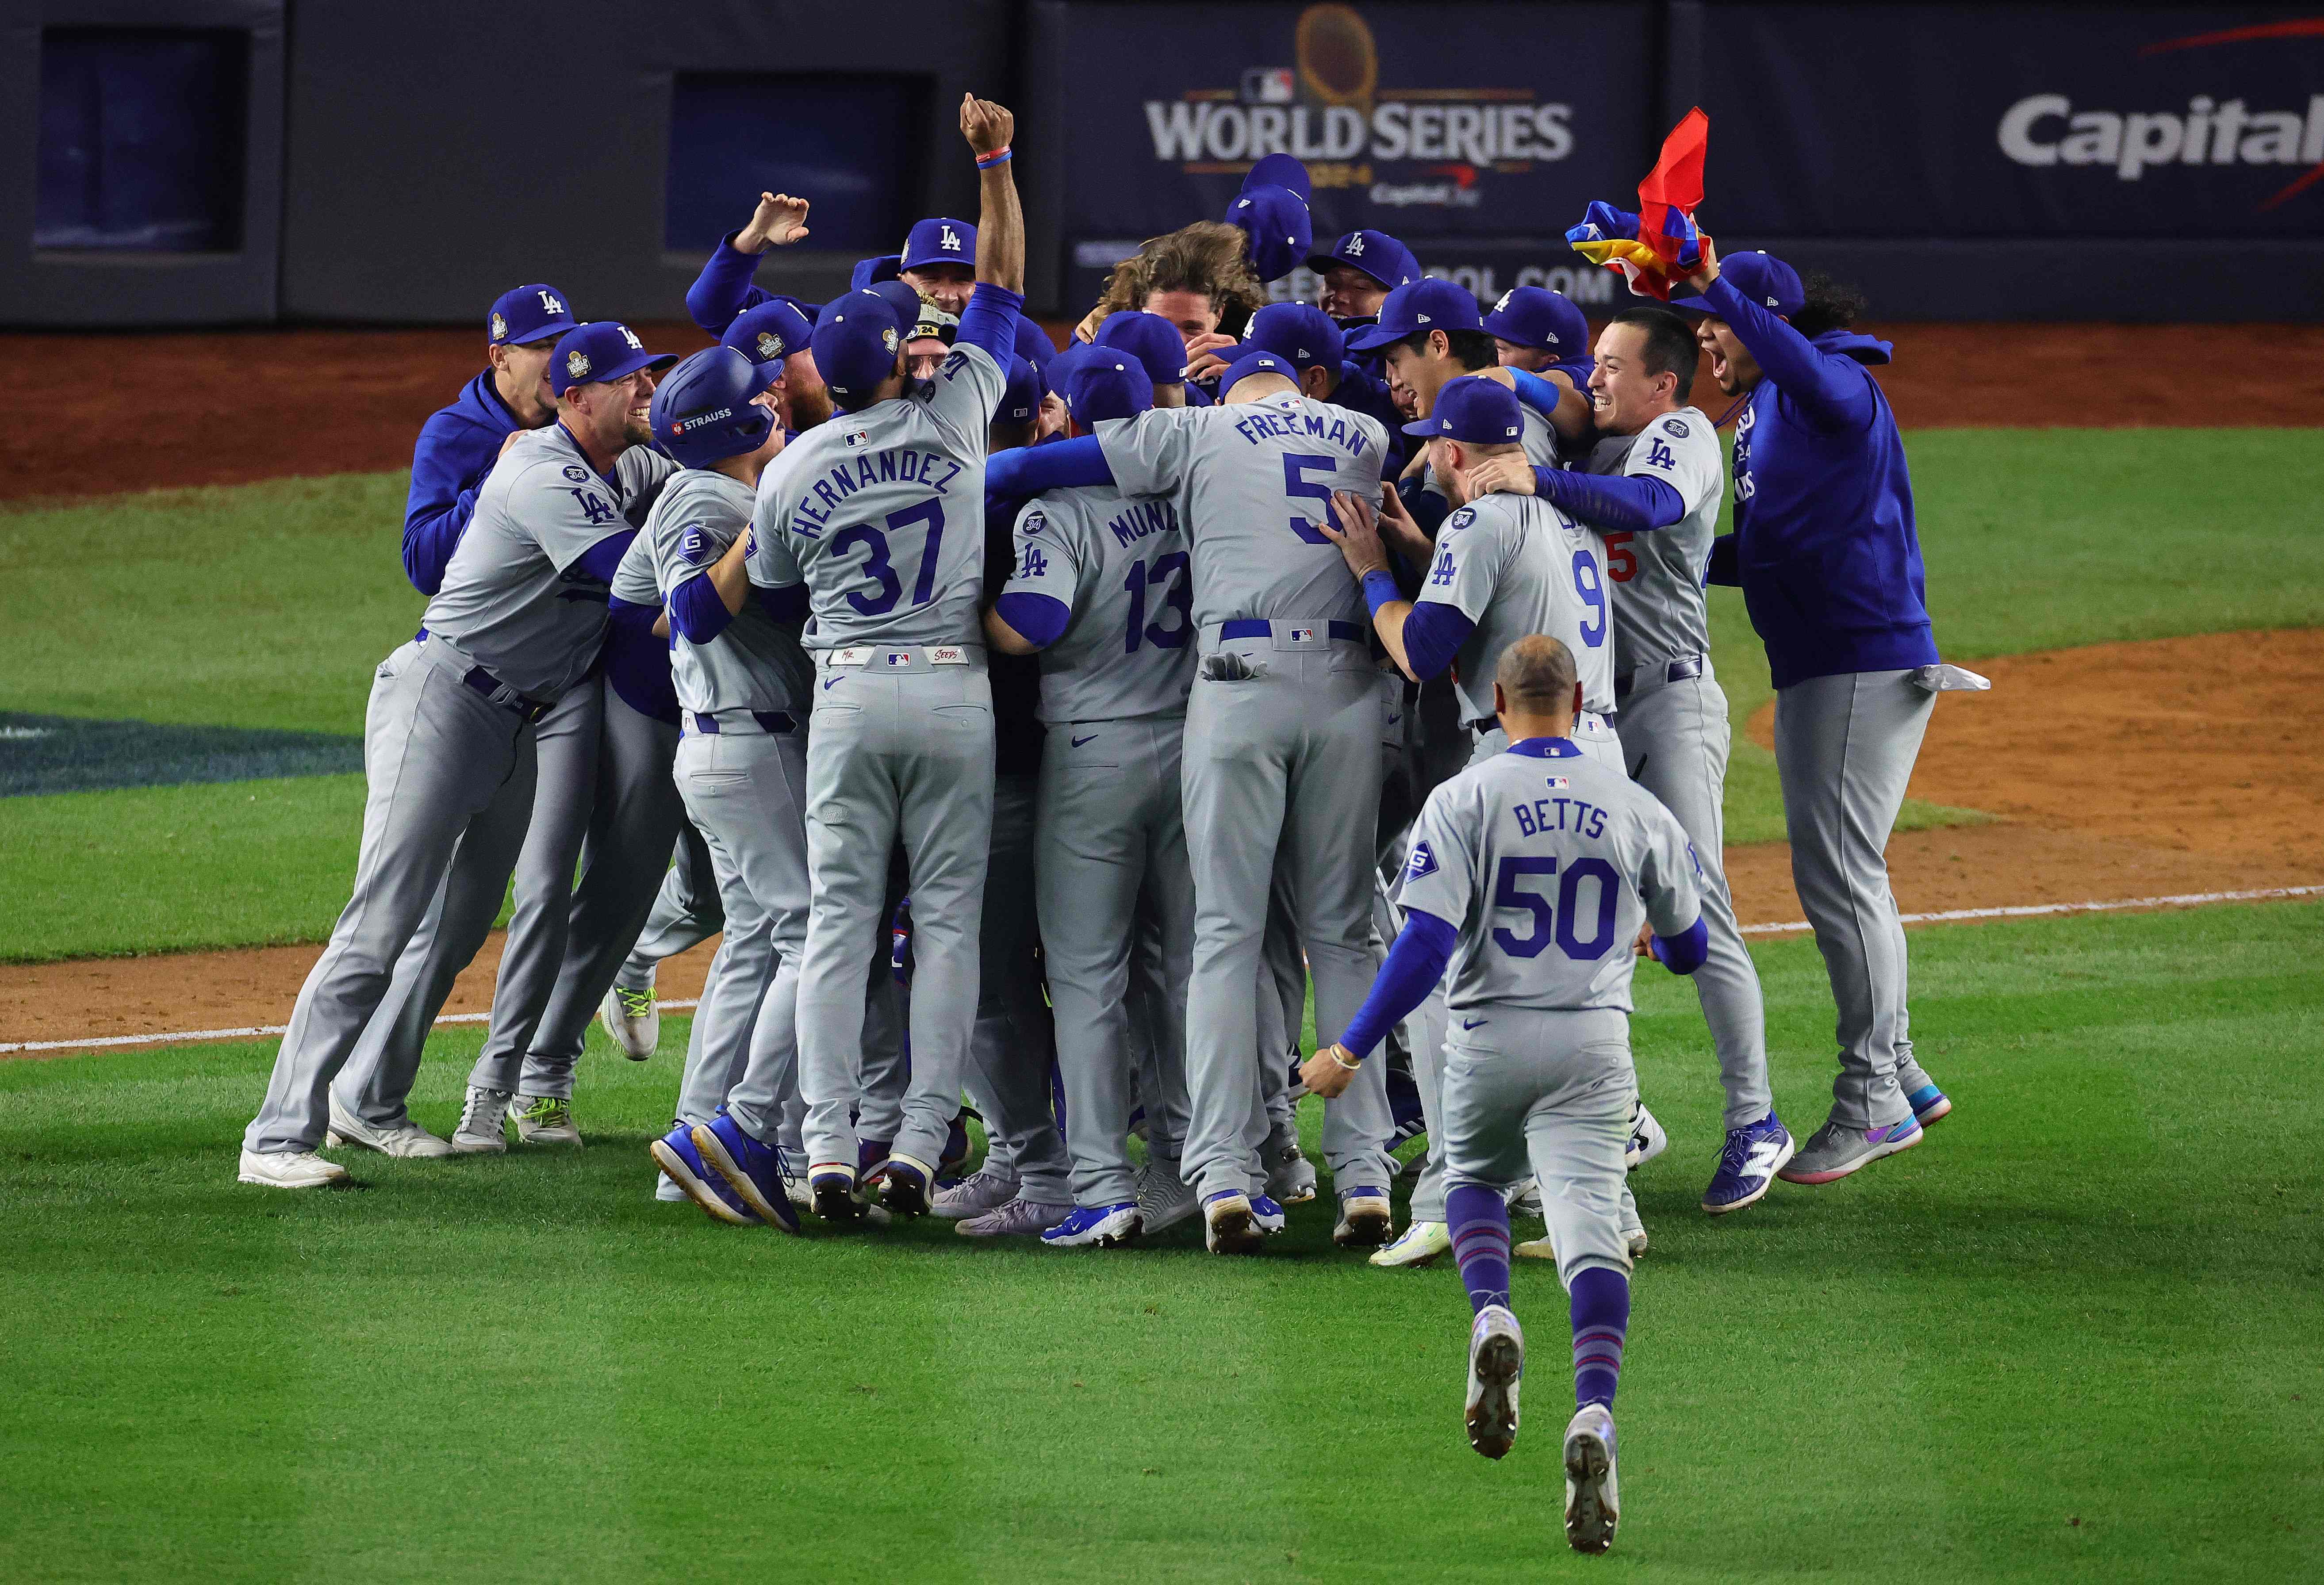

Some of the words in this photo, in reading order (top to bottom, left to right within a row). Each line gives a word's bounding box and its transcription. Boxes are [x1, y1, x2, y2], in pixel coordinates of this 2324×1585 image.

[1145, 102, 1366, 160] WORLD
[1371, 102, 1574, 167] SERIES
[1997, 94, 2324, 180] Capital
[941, 226, 960, 251] LA
[1345, 232, 1364, 256] LA
[538, 291, 564, 314] LA
[617, 326, 643, 349] LA
[568, 358, 587, 371] WORLD
[571, 364, 589, 375] SERIES
[684, 408, 732, 431] STRAUSS
[1235, 412, 1367, 458] FREEMAN
[1668, 424, 1685, 436] 34
[1646, 437, 1676, 471] LA
[569, 471, 586, 479] 34
[571, 487, 615, 525] LA
[1282, 452, 1345, 545] 5
[1026, 519, 1041, 531] 34
[1454, 514, 1469, 526] 34
[684, 534, 701, 550] G
[830, 496, 945, 616] 37
[1604, 531, 1638, 582] 5
[1021, 542, 1048, 578] LA
[1431, 542, 1456, 586] LA
[1124, 551, 1194, 654] 13
[1572, 550, 1606, 647] 9
[1513, 798, 1607, 838] BETTS
[1409, 850, 1428, 867] G
[1492, 857, 1620, 961] 50
